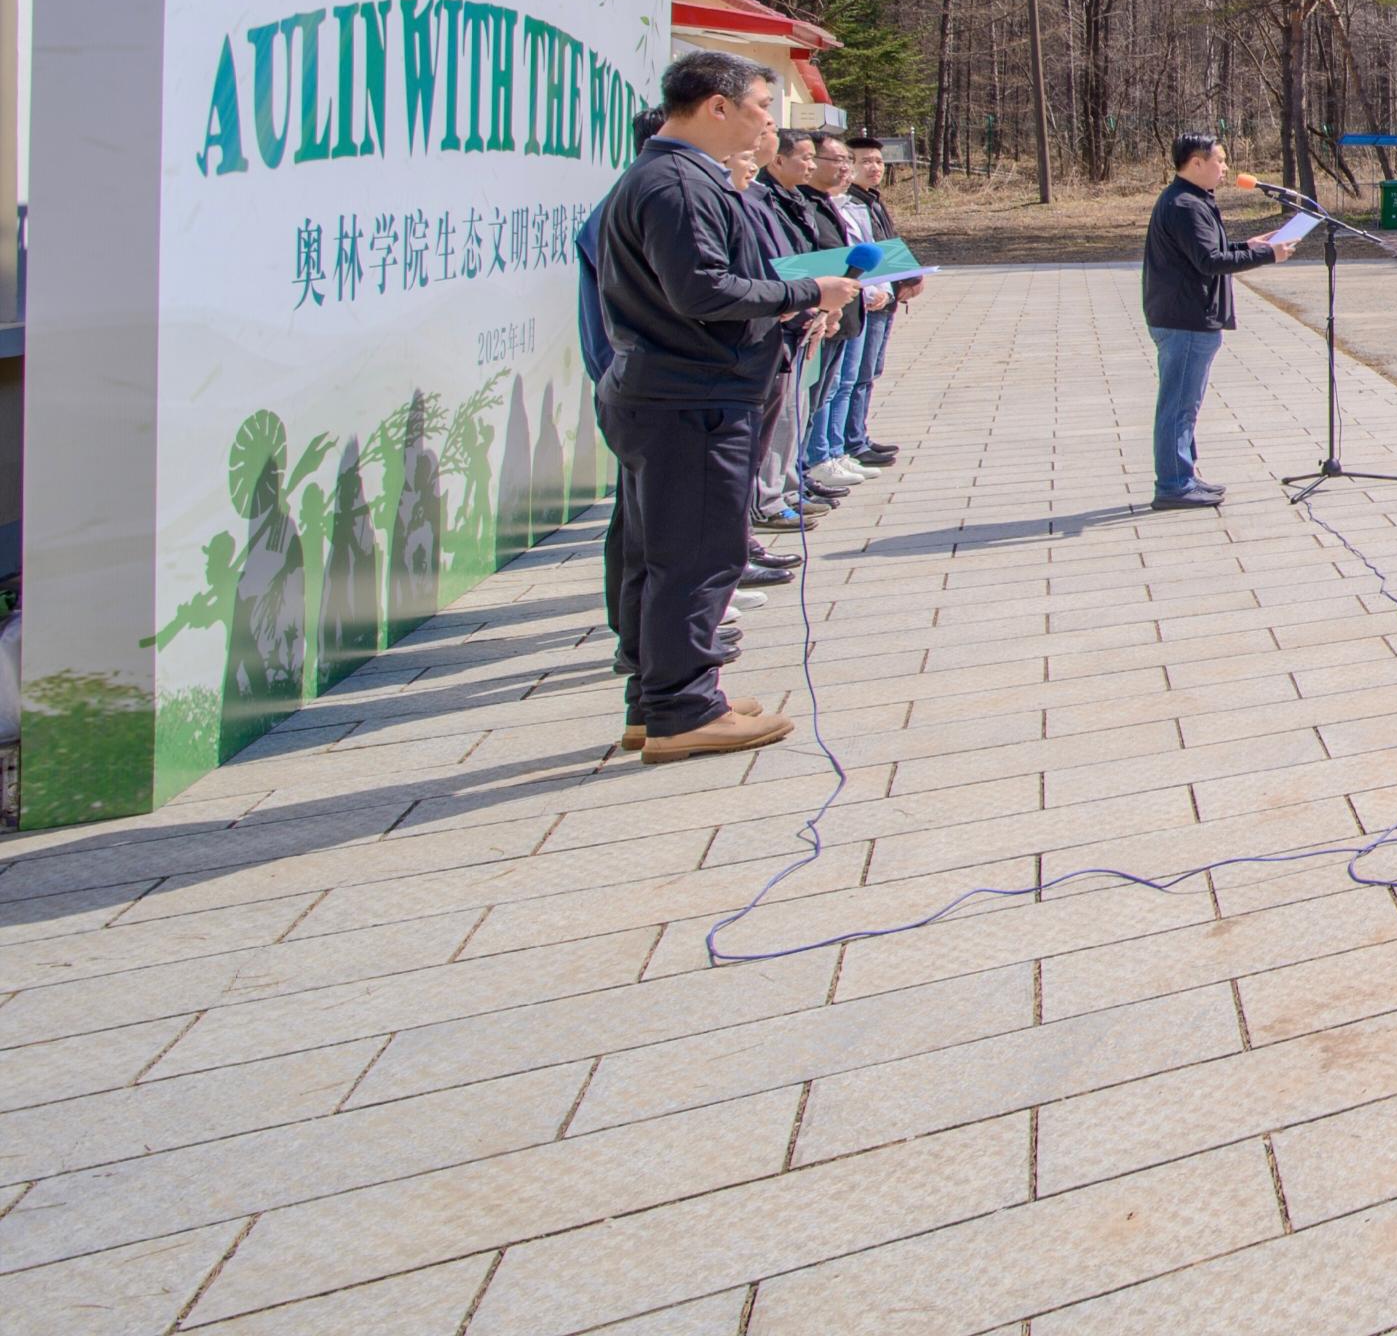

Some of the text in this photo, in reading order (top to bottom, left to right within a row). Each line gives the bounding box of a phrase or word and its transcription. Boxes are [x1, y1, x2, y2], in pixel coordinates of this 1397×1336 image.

[523, 14, 584, 160] THE
[589, 48, 650, 170] WOR
[291, 203, 592, 311] 奥林学院生态文明实践植
[478, 317, 536, 366] 2025年4月
